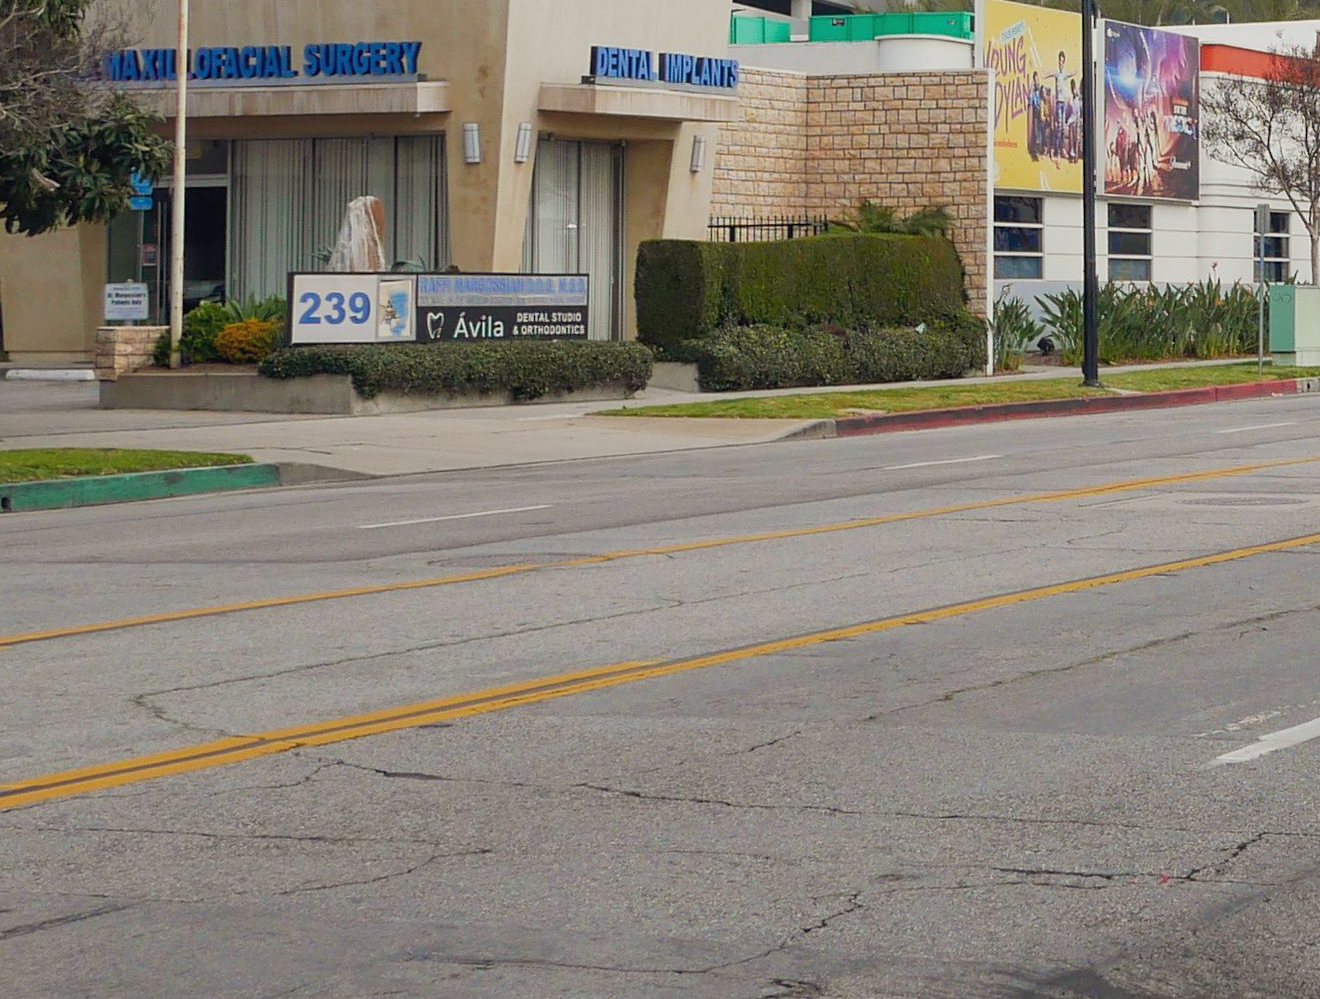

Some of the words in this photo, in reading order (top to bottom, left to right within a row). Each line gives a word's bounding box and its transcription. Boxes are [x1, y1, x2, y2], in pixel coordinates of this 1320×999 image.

[303, 41, 422, 76] SURGERY
[591, 46, 657, 81] DENTAL
[660, 53, 739, 88] IMPLANTS
[299, 292, 371, 324] 239
[517, 313, 550, 322] DENTAL
[552, 313, 582, 322] STUDIO
[453, 312, 504, 338] Ávila
[512, 325, 519, 334] &
[521, 325, 584, 335] ORTHODONTICS
